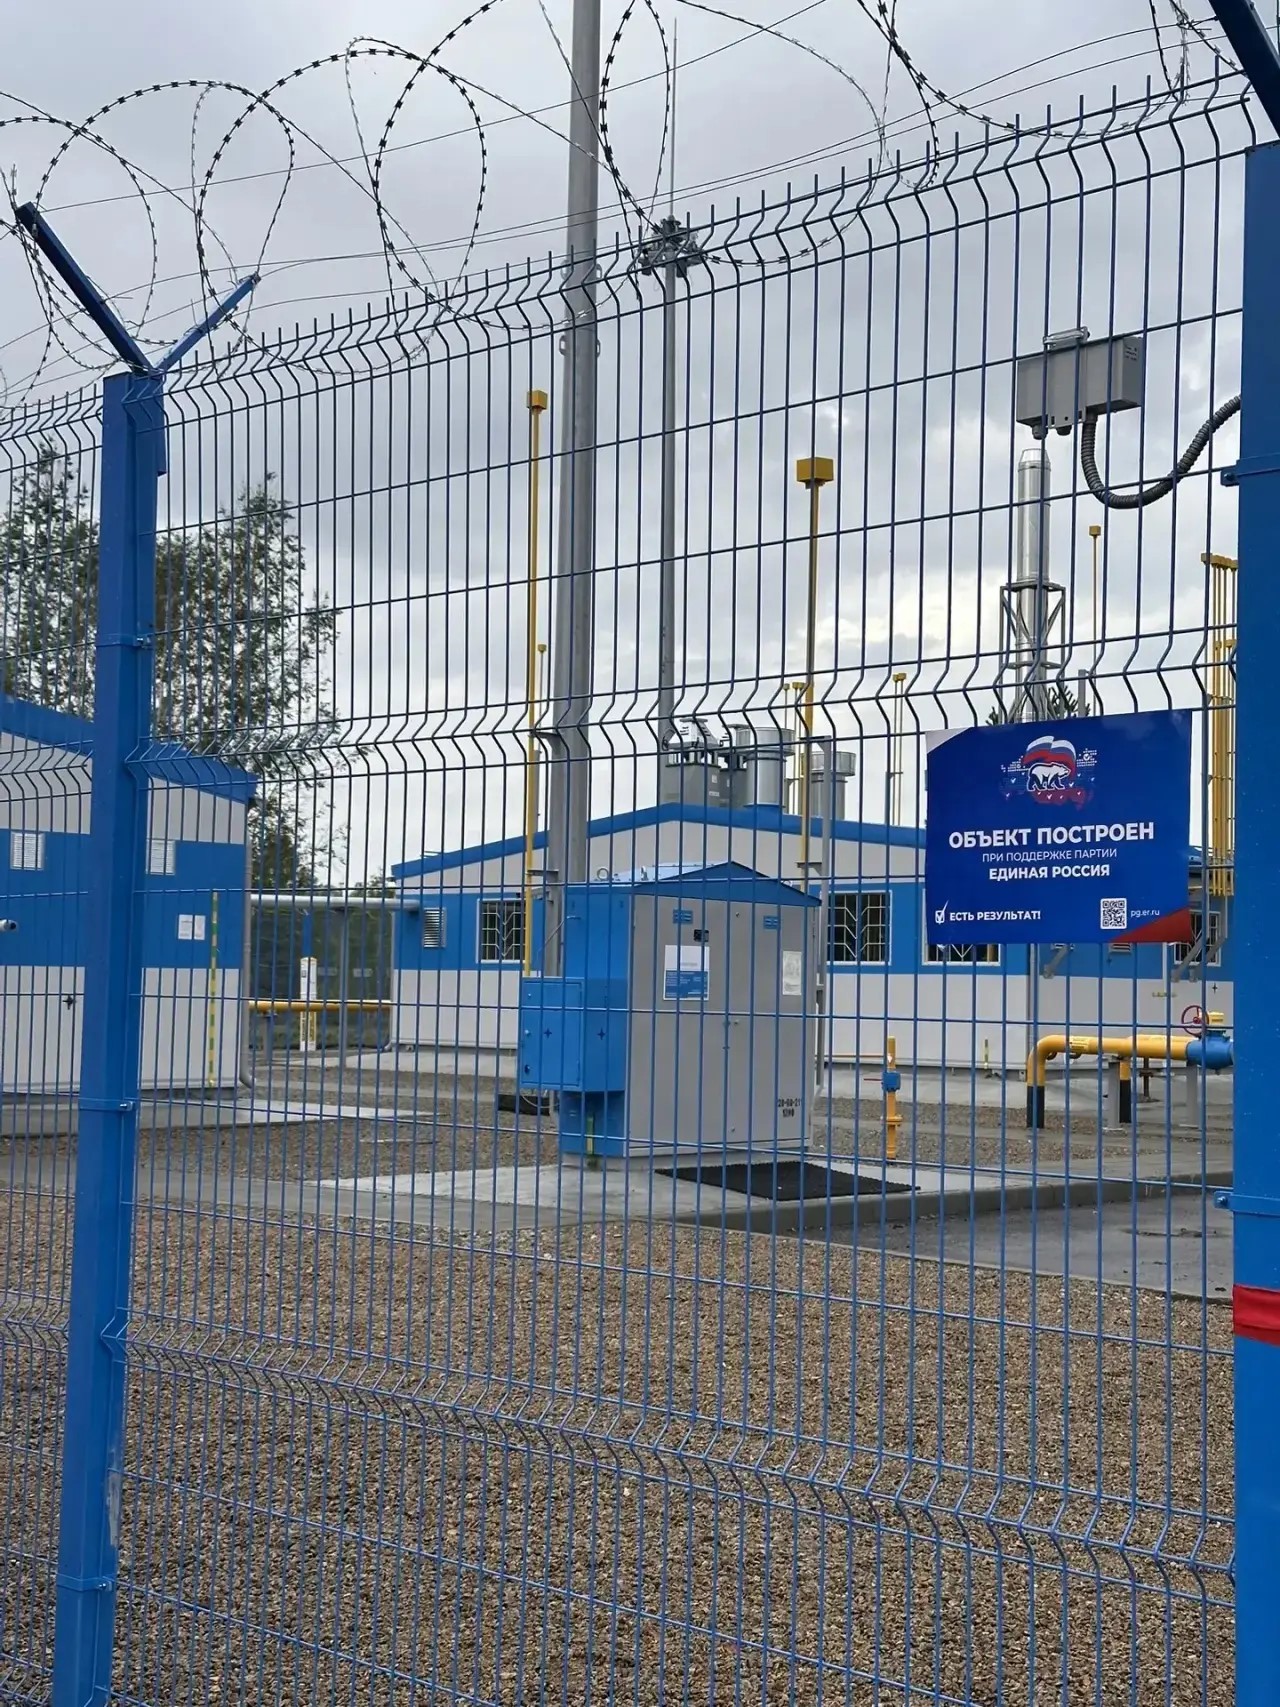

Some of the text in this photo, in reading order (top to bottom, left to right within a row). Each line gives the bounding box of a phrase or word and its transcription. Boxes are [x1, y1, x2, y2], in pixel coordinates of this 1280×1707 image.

[949, 822, 1154, 848] ОБЪЕКТ ПОСТРОЕН
[982, 848, 1117, 862] ПРИ ПОДДЕРЖКЕ ПАРТИИ
[989, 864, 1110, 881] ЕДИНАЯ РОССИЯ
[949, 910, 1041, 921] ЕСТЬ РЕЗУЛЬТАТ!
[1130, 909, 1160, 917] pg.er.ru
